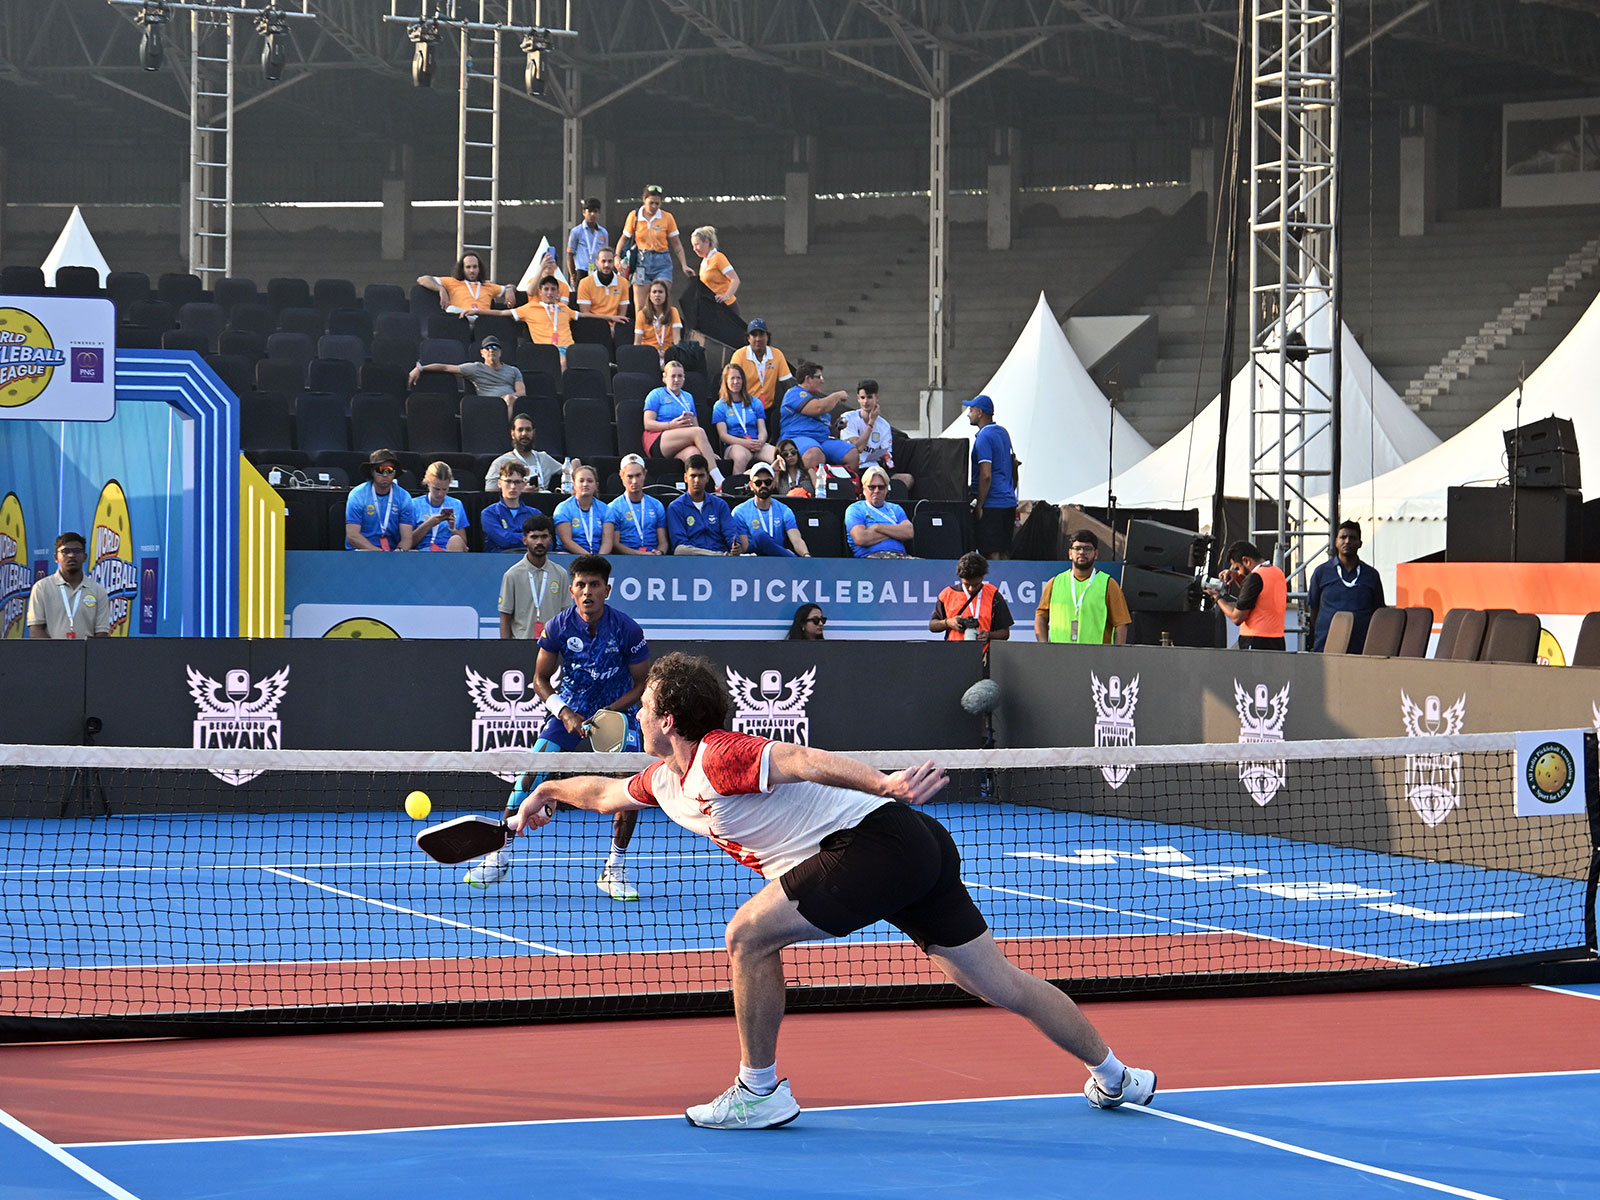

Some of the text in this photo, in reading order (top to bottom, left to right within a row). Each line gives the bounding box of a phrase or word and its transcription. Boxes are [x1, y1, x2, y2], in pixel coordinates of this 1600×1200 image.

[0, 331, 27, 343] RLD
[0, 346, 64, 363] LEBALL
[0, 365, 45, 385] EAGUE
[731, 579, 938, 604] PICKLEBALL
[209, 722, 265, 730] BENGALURU
[487, 721, 539, 729] BENGALURU
[746, 719, 795, 728] BENGALURU
[475, 724, 539, 752] JAWAN
[1536, 745, 1560, 757] Pickleball
